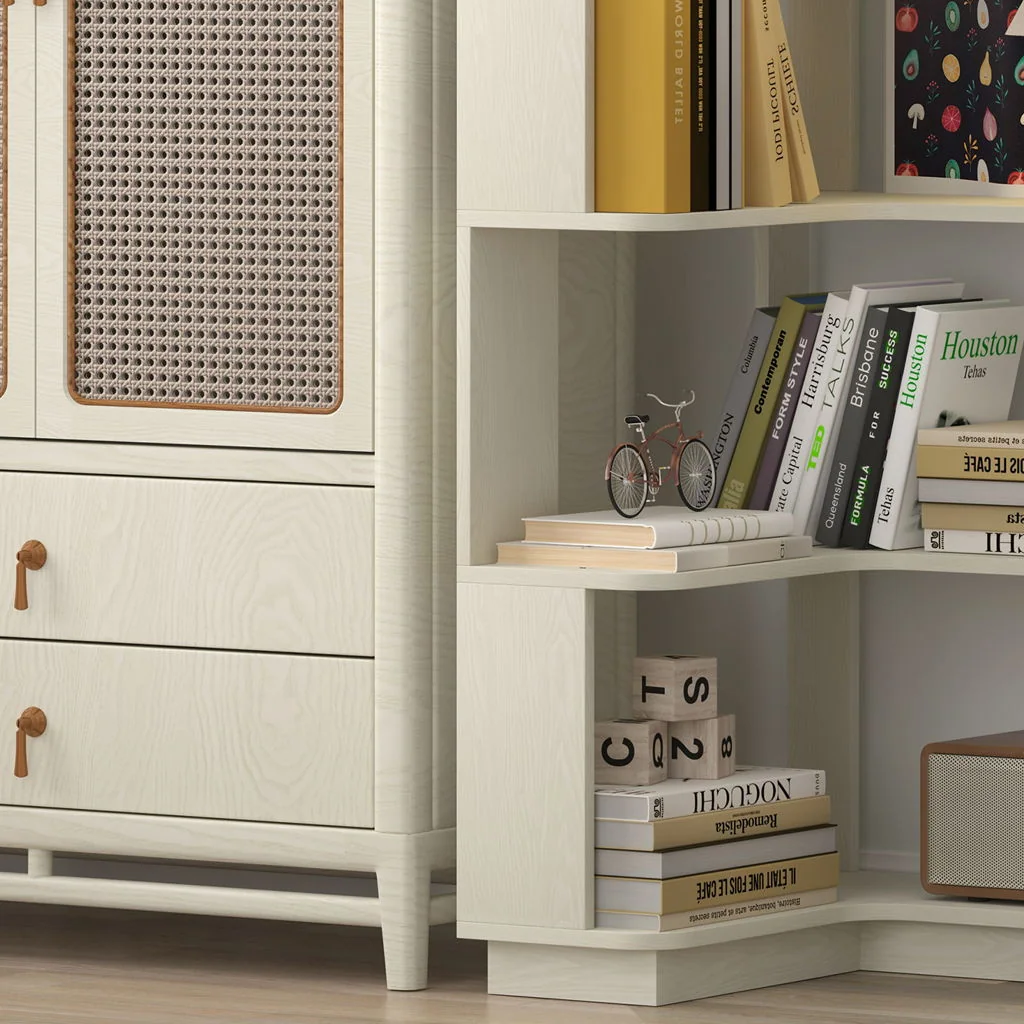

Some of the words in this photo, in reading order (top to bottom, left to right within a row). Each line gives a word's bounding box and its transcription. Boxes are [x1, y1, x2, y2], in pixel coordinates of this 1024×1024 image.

[741, 335, 759, 374] Columbia
[940, 330, 1019, 361] Houston
[754, 329, 787, 415] Contemporan
[801, 314, 841, 409] Harrisburg
[850, 327, 880, 408] Brisbane
[900, 333, 928, 409] Houston
[963, 364, 988, 379] Tehas
[772, 393, 792, 440] FORM
[787, 337, 808, 389] STYLE
[805, 424, 825, 472] TED
[821, 318, 855, 412] TALKS
[850, 465, 870, 526] FORMULA
[869, 411, 881, 439] FOR
[879, 330, 898, 390] SUCCESS
[782, 436, 803, 485] Capital
[825, 462, 847, 529] Queensland
[877, 487, 895, 523] Tehas
[641, 675, 666, 703] T
[683, 676, 710, 705] S
[601, 737, 635, 767] C
[652, 732, 664, 769] Q
[671, 736, 704, 761] 2
[693, 777, 792, 814] NOGUCHI
[715, 812, 778, 835] Remodelista
[697, 879, 717, 904] CAFÉ
[718, 877, 729, 897] LE
[729, 874, 748, 894] FOIS
[748, 871, 765, 892] UNE
[766, 869, 788, 890] ÉTAIT
[788, 867, 797, 885] IL
[689, 912, 711, 923] secrets
